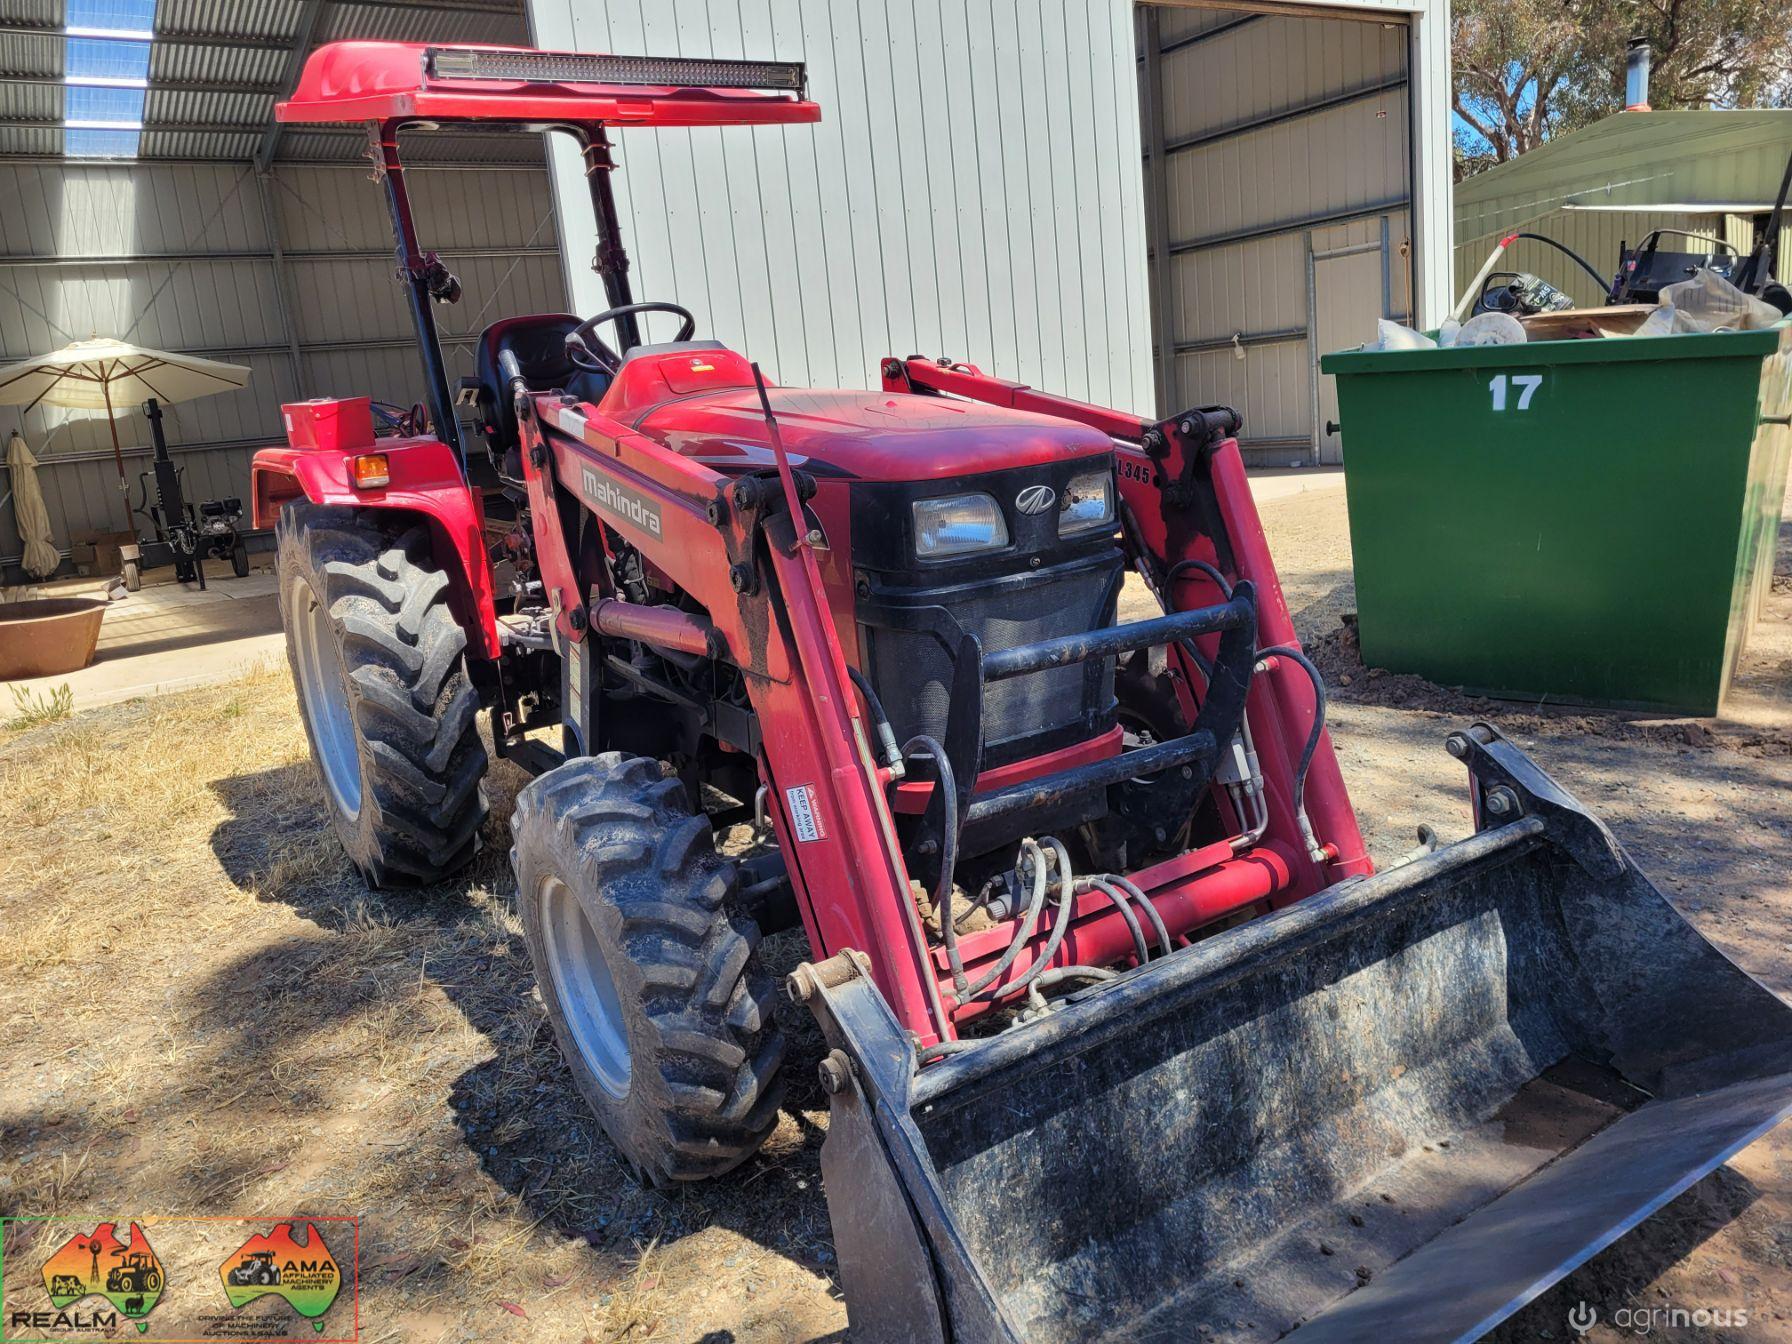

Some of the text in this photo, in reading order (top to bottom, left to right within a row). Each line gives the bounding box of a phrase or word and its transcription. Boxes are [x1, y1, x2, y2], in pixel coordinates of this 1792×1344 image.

[1489, 374, 1542, 411] 17
[582, 467, 661, 535] Mahindra
[796, 789, 815, 838] KEEP AWAY
[811, 799, 825, 838] WARNING
